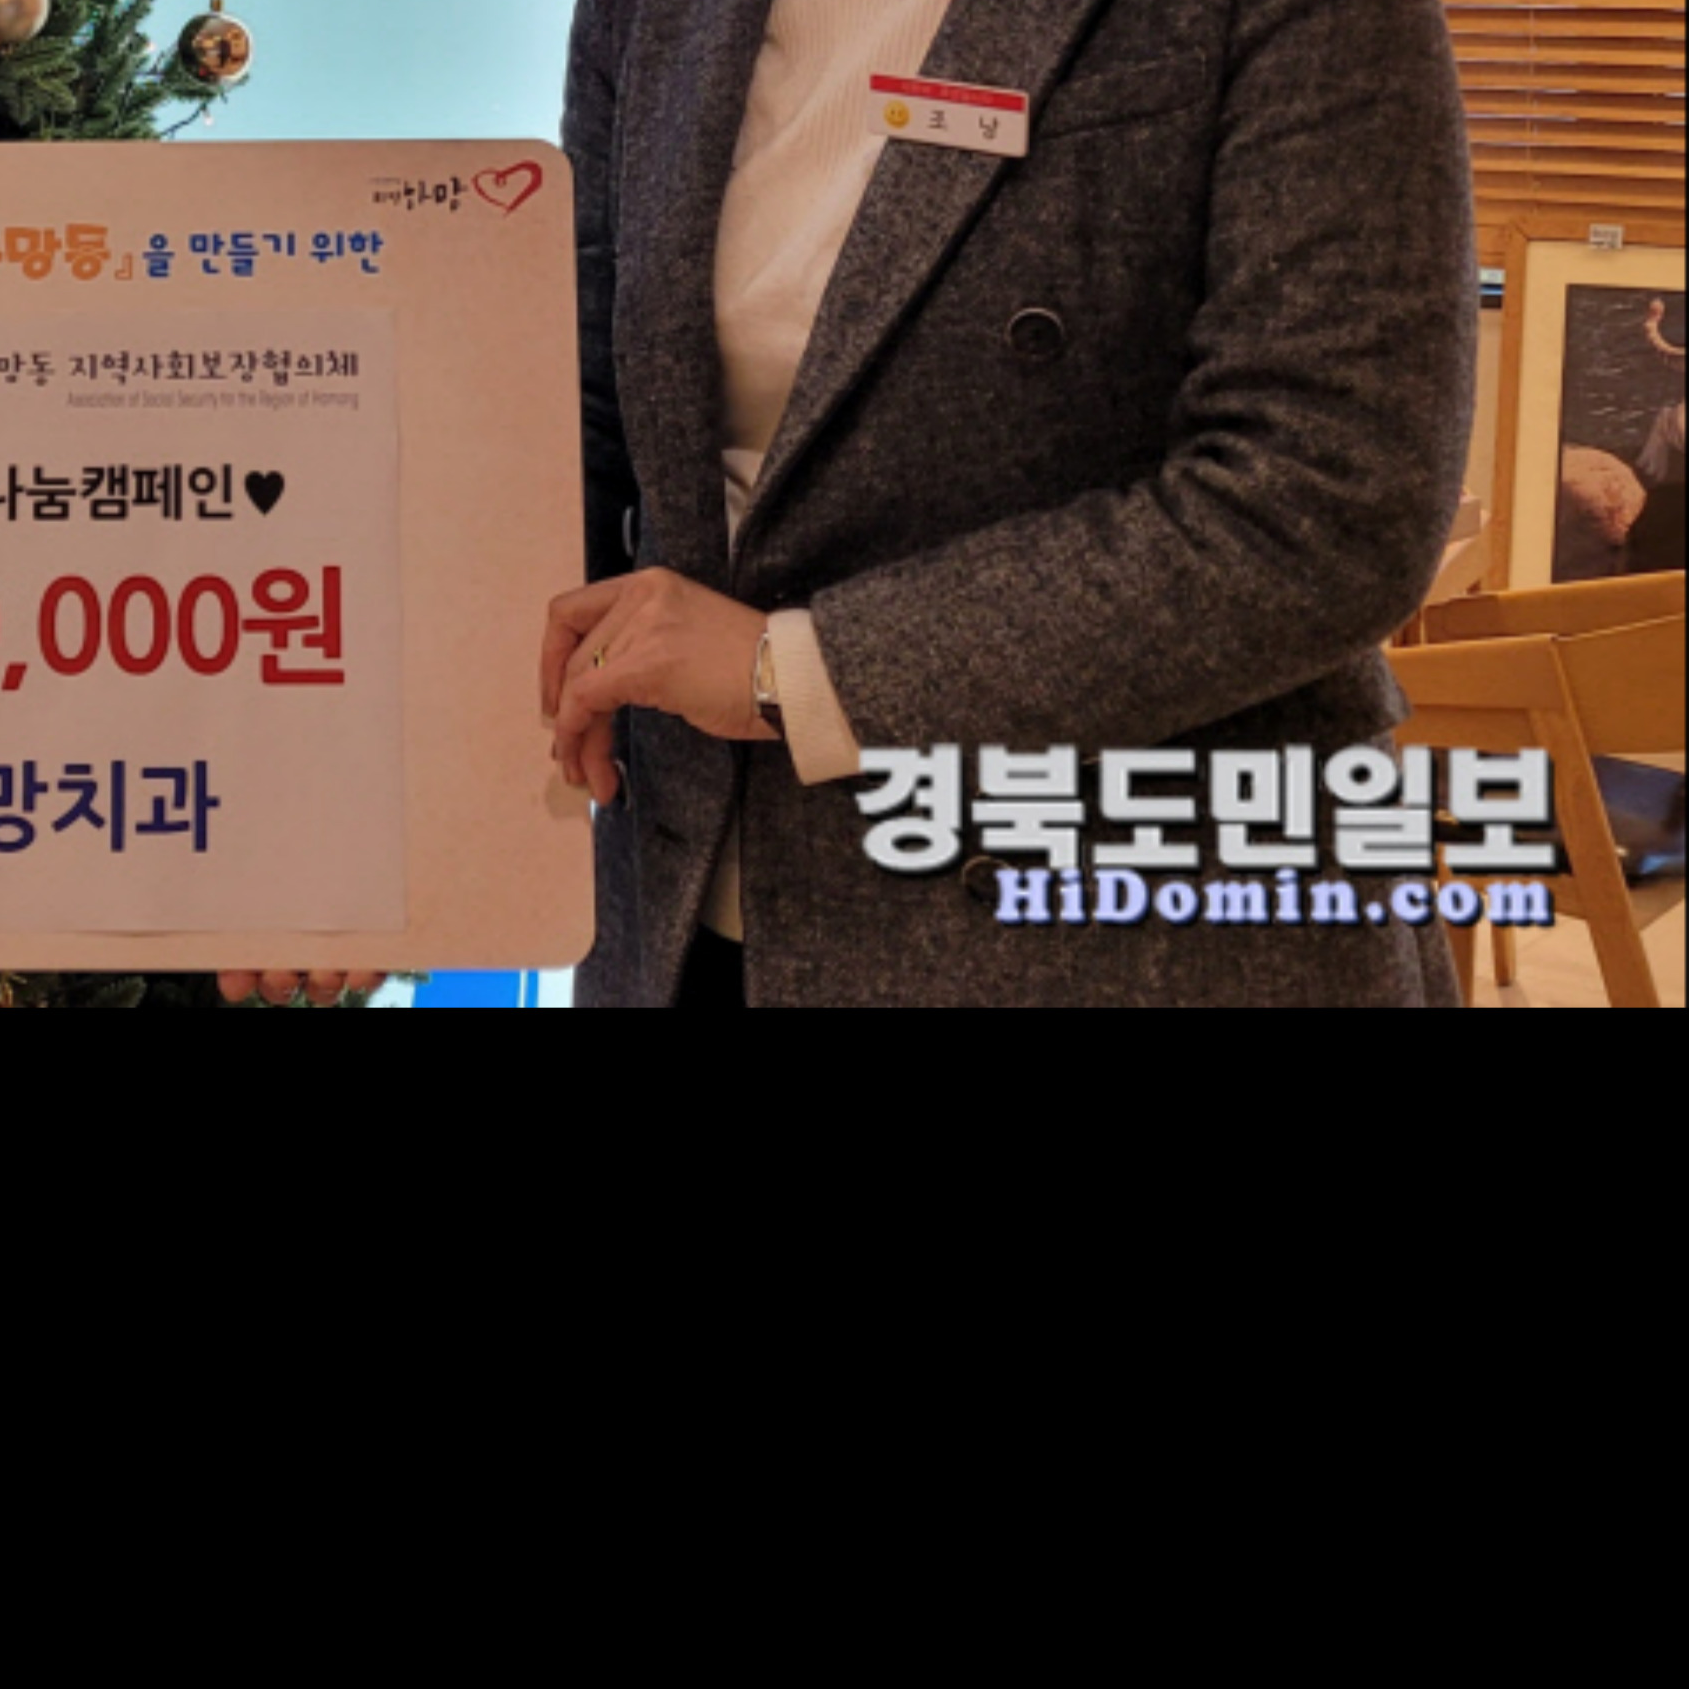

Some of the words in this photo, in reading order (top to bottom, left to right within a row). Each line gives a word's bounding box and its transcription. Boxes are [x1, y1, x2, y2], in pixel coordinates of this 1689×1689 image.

[188, 231, 296, 278] 만들기
[309, 231, 385, 275] 위한
[68, 349, 360, 388] 지역사회보장협의체
